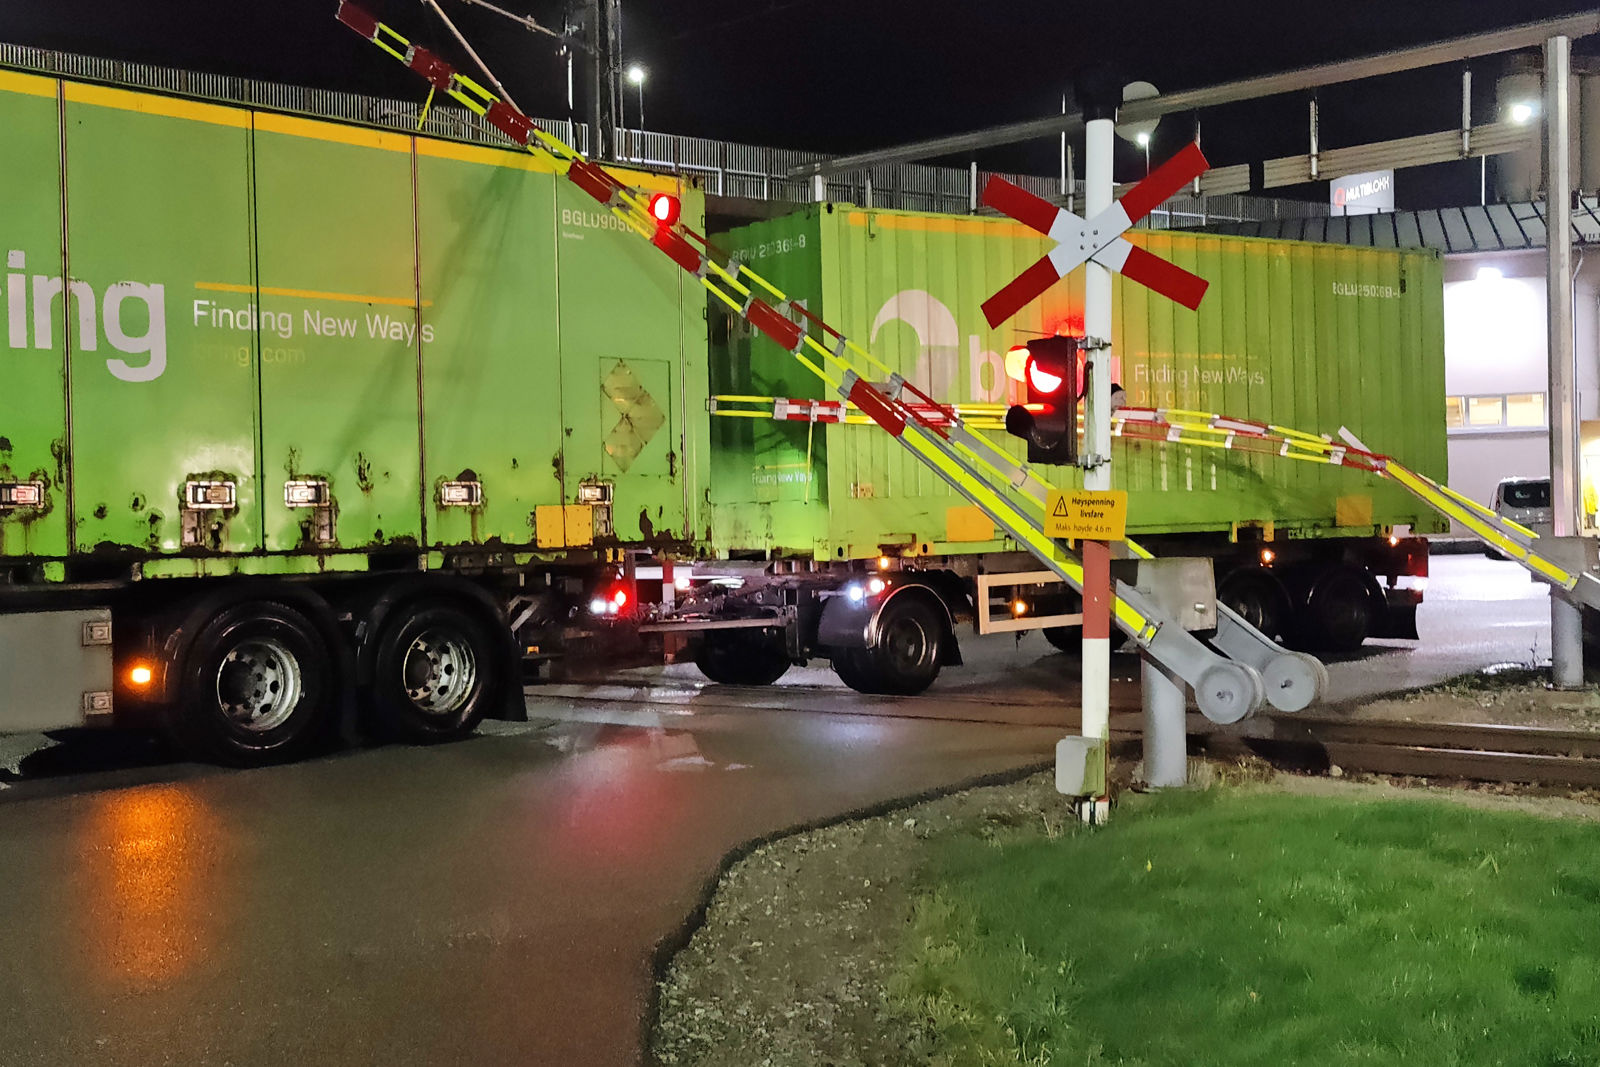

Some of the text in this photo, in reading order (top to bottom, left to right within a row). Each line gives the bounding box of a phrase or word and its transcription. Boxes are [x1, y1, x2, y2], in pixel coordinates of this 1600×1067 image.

[0, 249, 168, 383] ing
[193, 299, 434, 348] Finding New Ways
[1134, 363, 1189, 388] Finding
[1071, 497, 1115, 508] Høyspenning
[1080, 510, 1104, 518] livsfare
[1055, 523, 1071, 531] Maks
[1073, 524, 1093, 533] høyde
